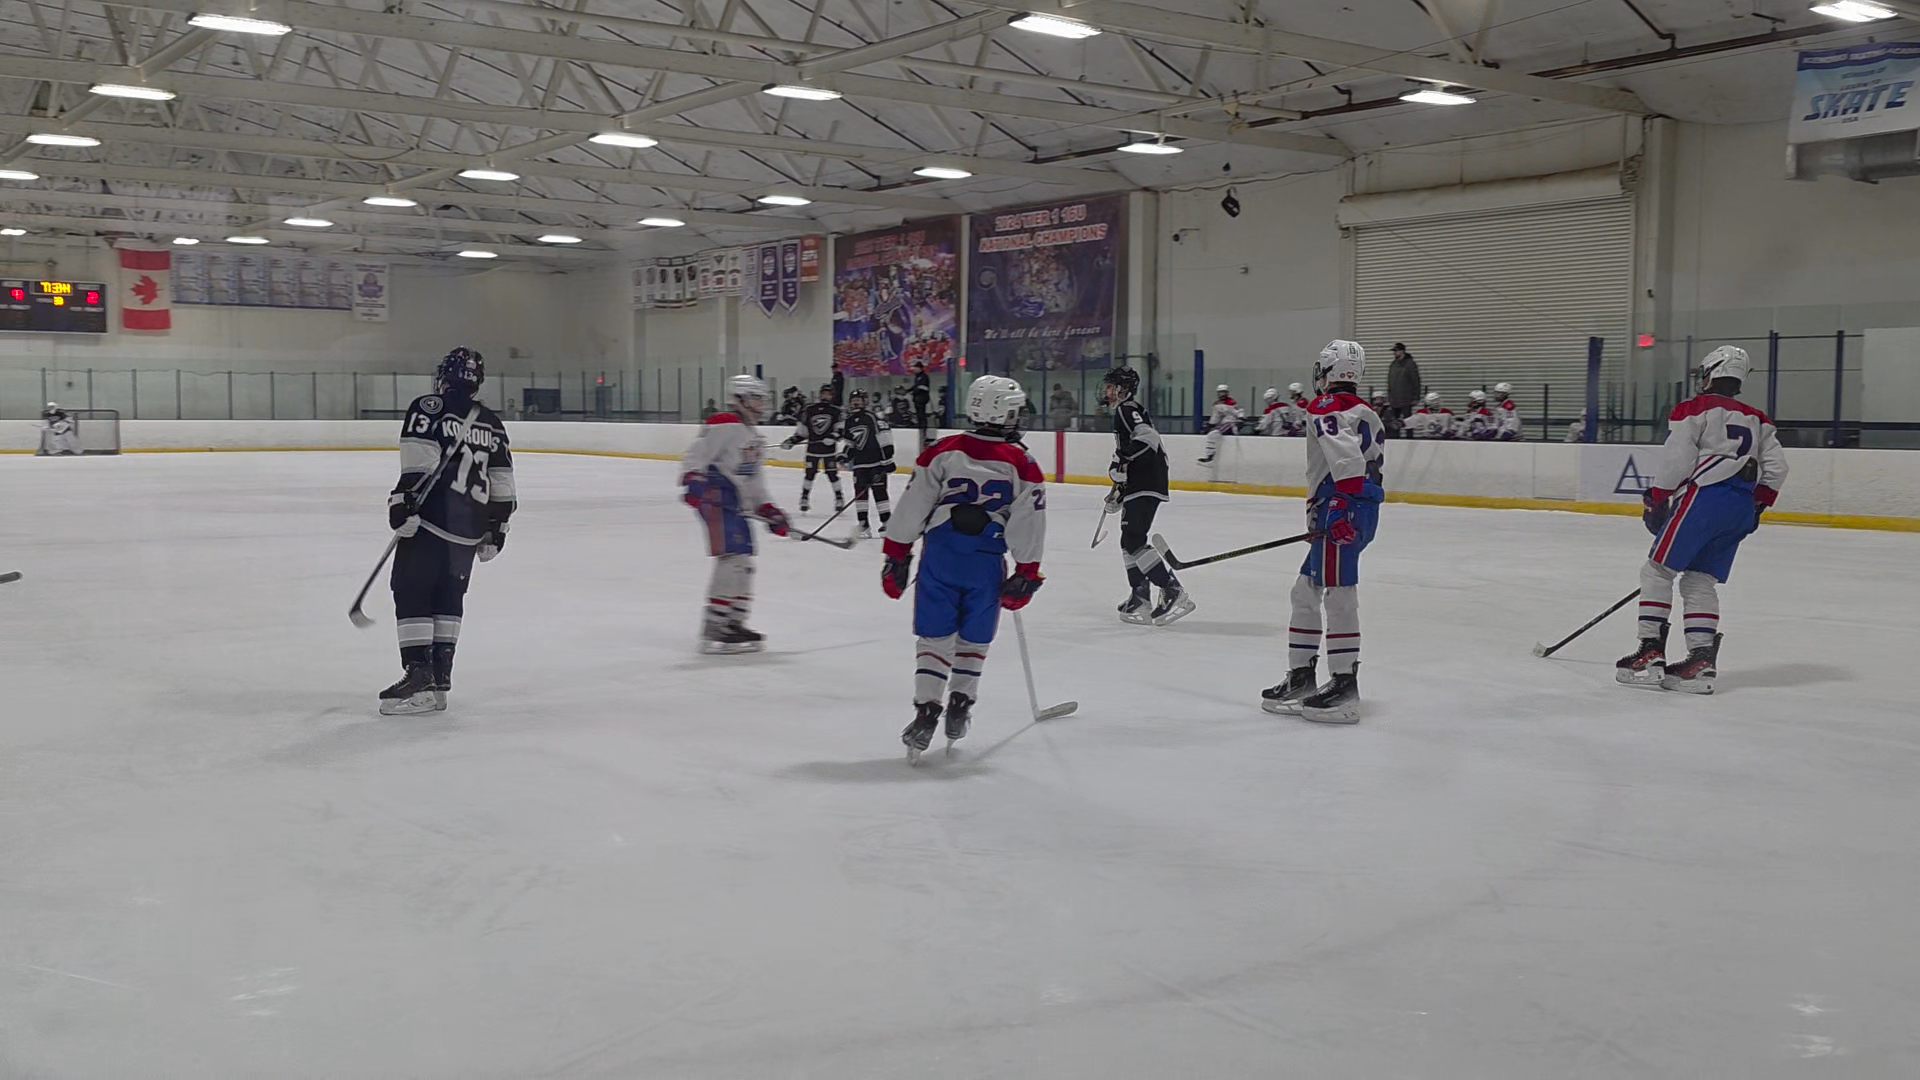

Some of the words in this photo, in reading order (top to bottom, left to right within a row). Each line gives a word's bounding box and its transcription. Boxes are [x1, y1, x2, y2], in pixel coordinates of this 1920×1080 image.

[1803, 81, 1915, 121] SKATE
[1021, 210, 1051, 229] TIER
[1051, 208, 1060, 224] 1
[1061, 204, 1088, 223] 16U
[979, 233, 1033, 252] NATIONAL
[1033, 223, 1109, 247] CHAMPIONS
[1063, 325, 1101, 340] forever
[407, 412, 431, 434] 13
[1131, 410, 1144, 424] 9
[1313, 415, 1339, 438] 13
[1726, 424, 1753, 460] 7
[450, 444, 490, 505] 13
[942, 477, 1014, 512] 22
